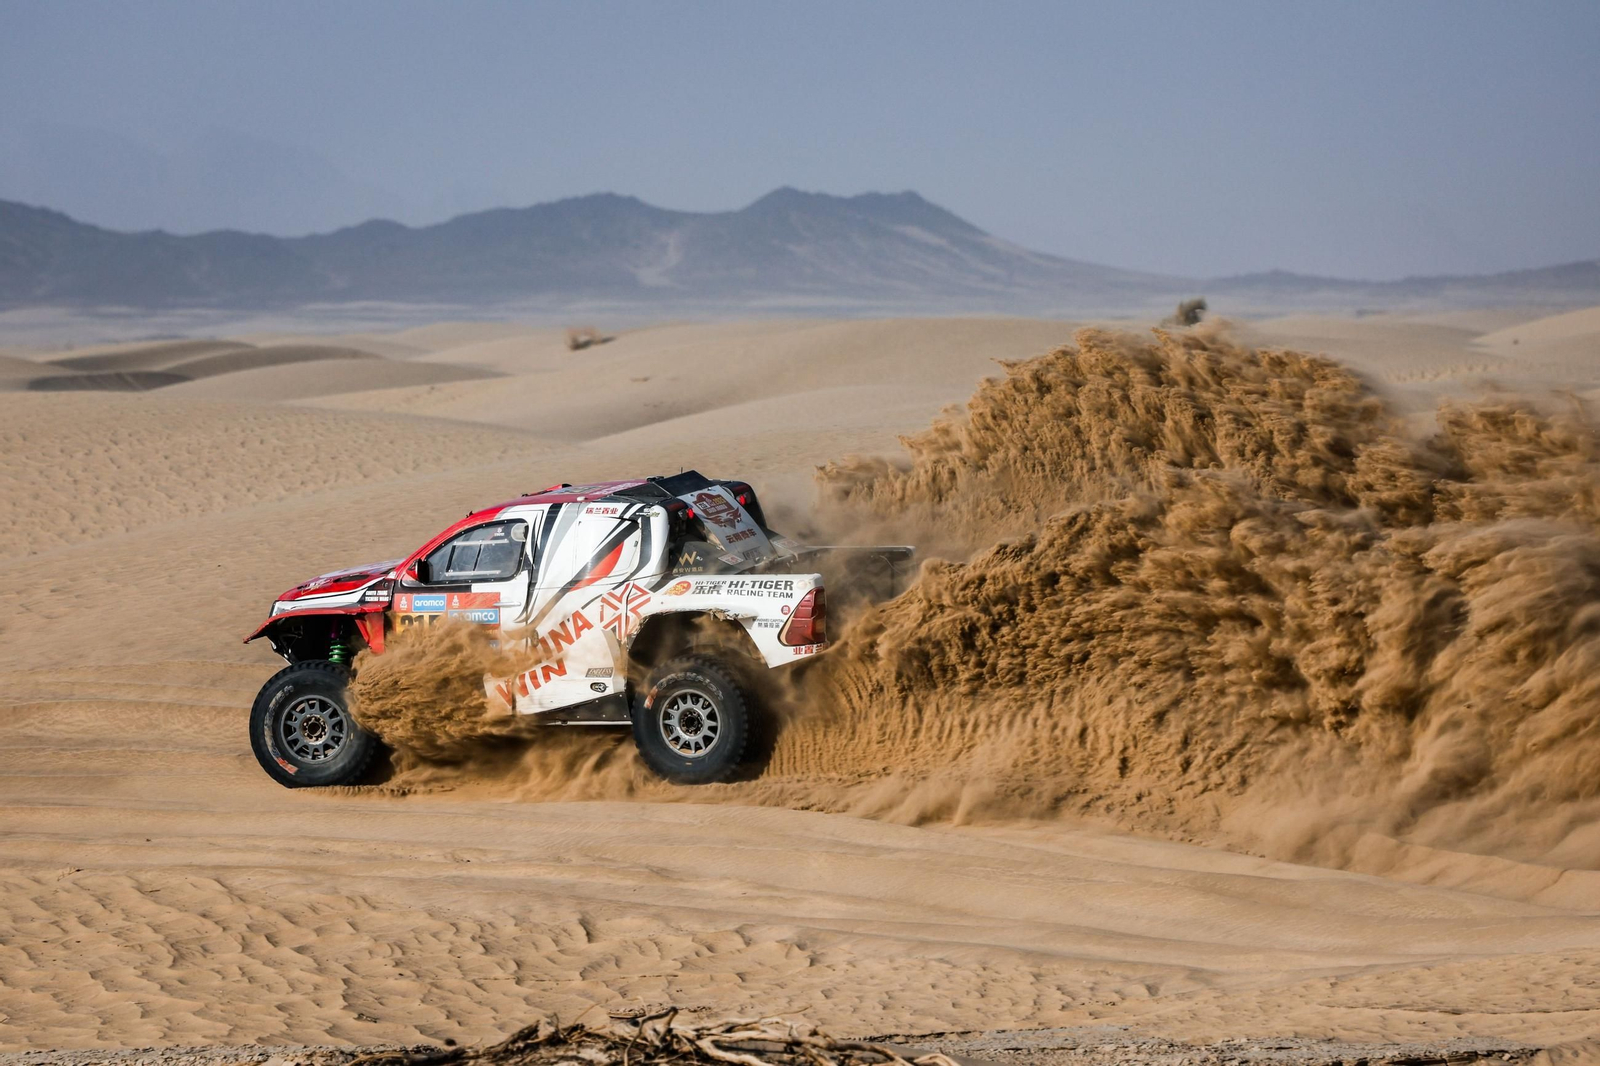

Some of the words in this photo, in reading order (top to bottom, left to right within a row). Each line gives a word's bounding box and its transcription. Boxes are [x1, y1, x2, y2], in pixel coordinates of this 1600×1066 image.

[728, 580, 794, 591] HI-TIGER
[726, 589, 764, 598] RACING
[767, 591, 793, 599] TEAM
